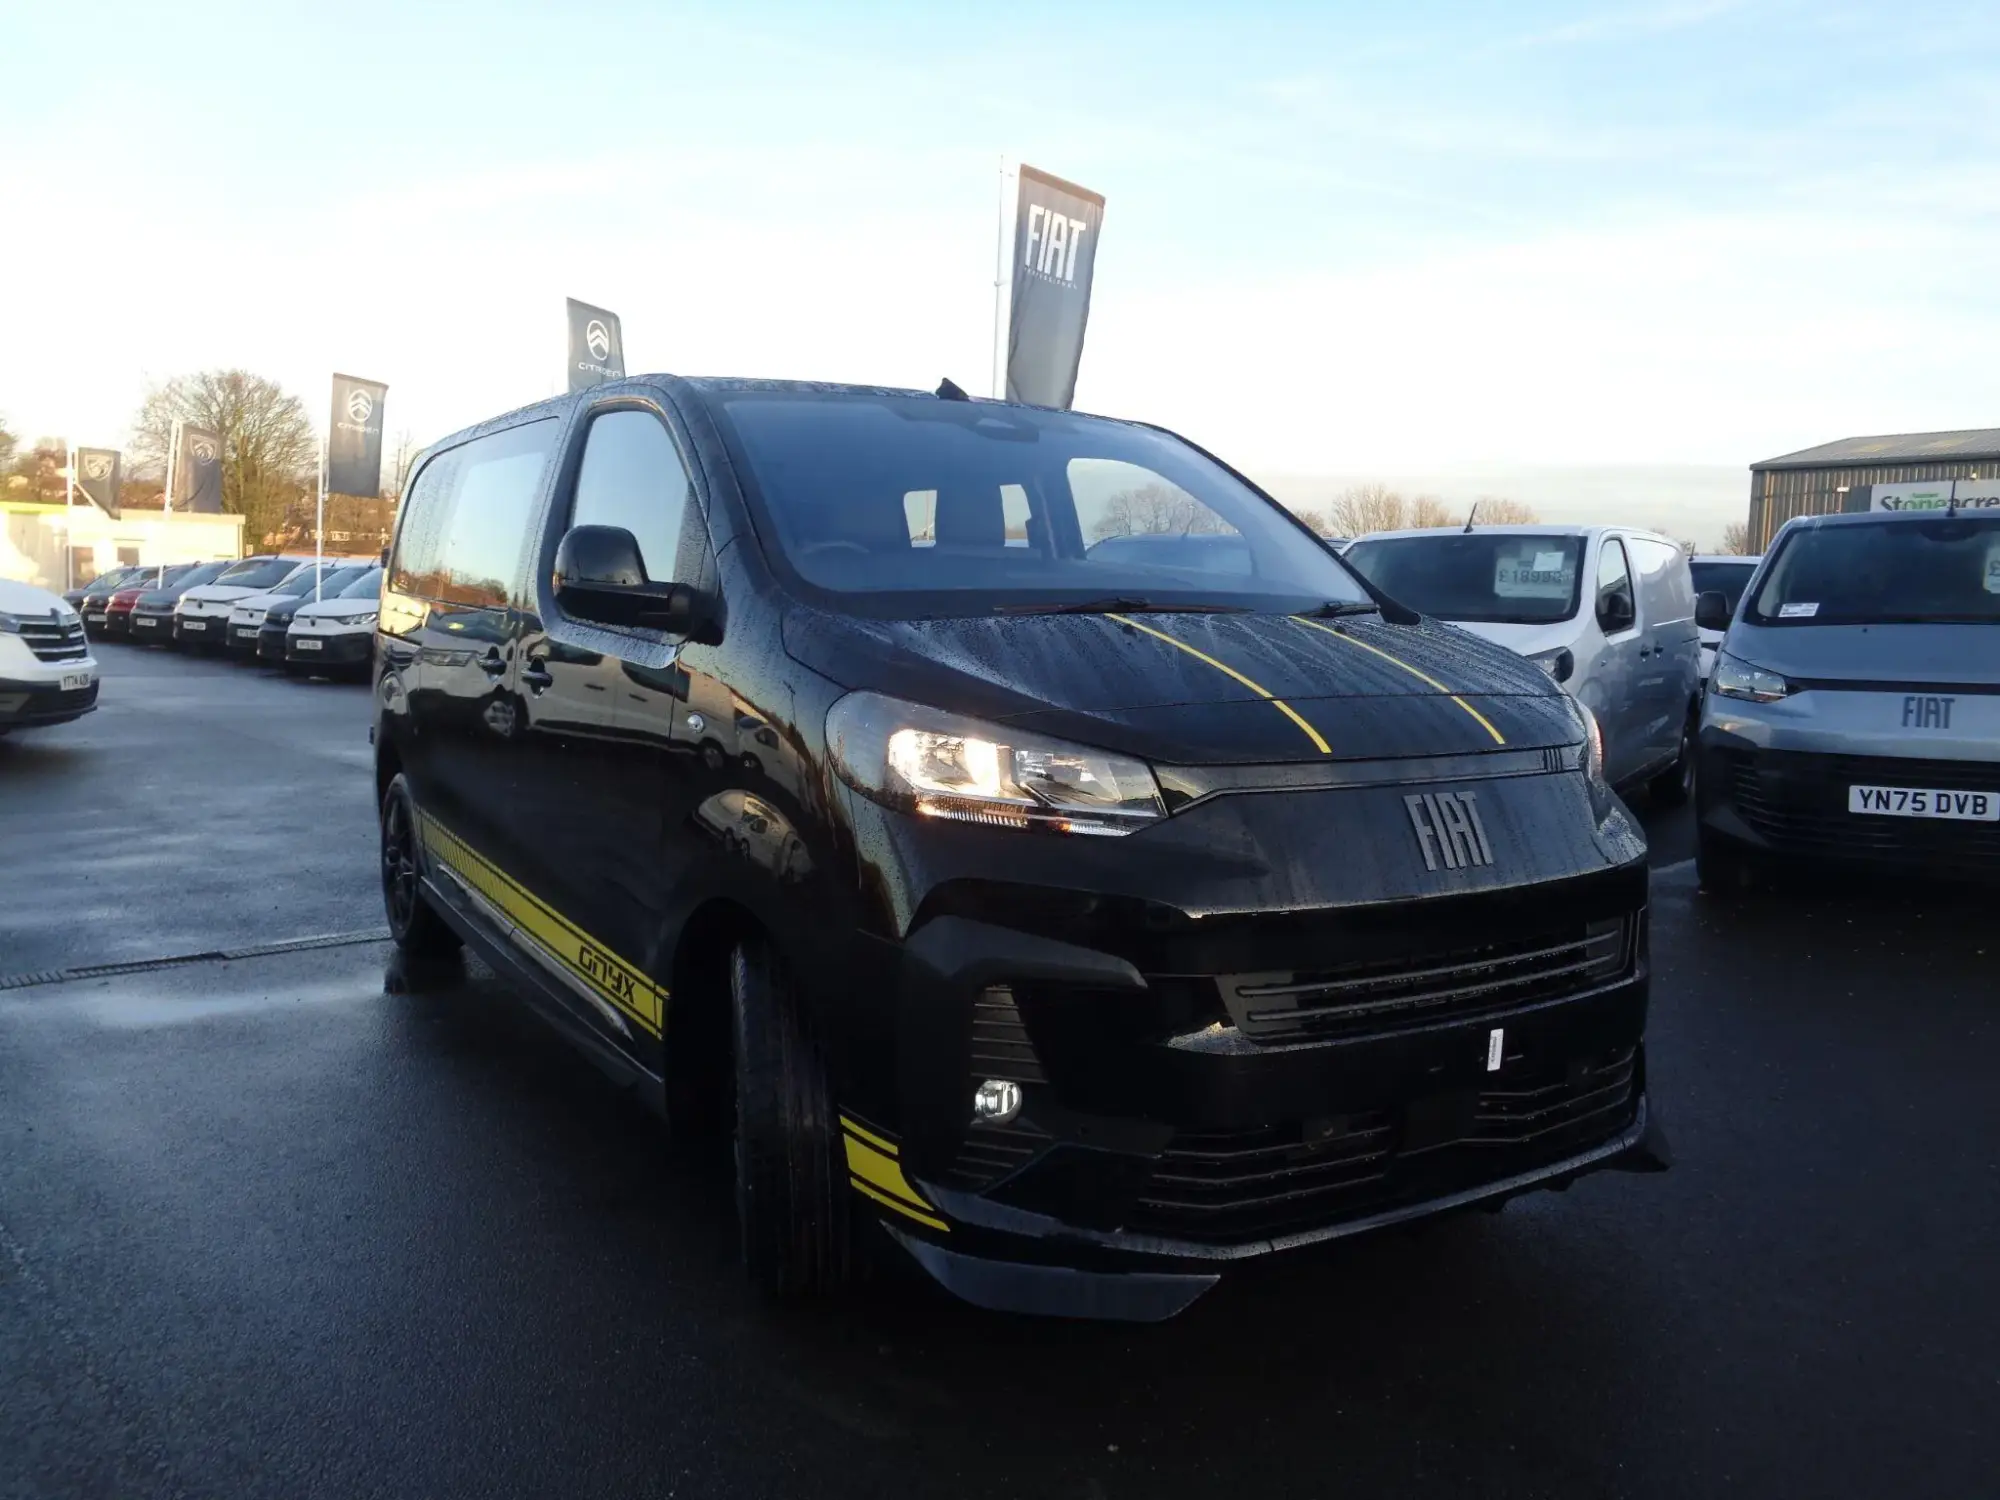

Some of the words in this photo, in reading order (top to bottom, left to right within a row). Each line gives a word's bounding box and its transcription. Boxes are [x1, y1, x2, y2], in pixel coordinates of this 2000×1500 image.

[1025, 203, 1086, 281] FIAT
[1901, 696, 1956, 729] FIAT
[1859, 788, 1927, 812] YN75
[1935, 793, 1988, 815] DVB
[1402, 791, 1495, 871] FIAT
